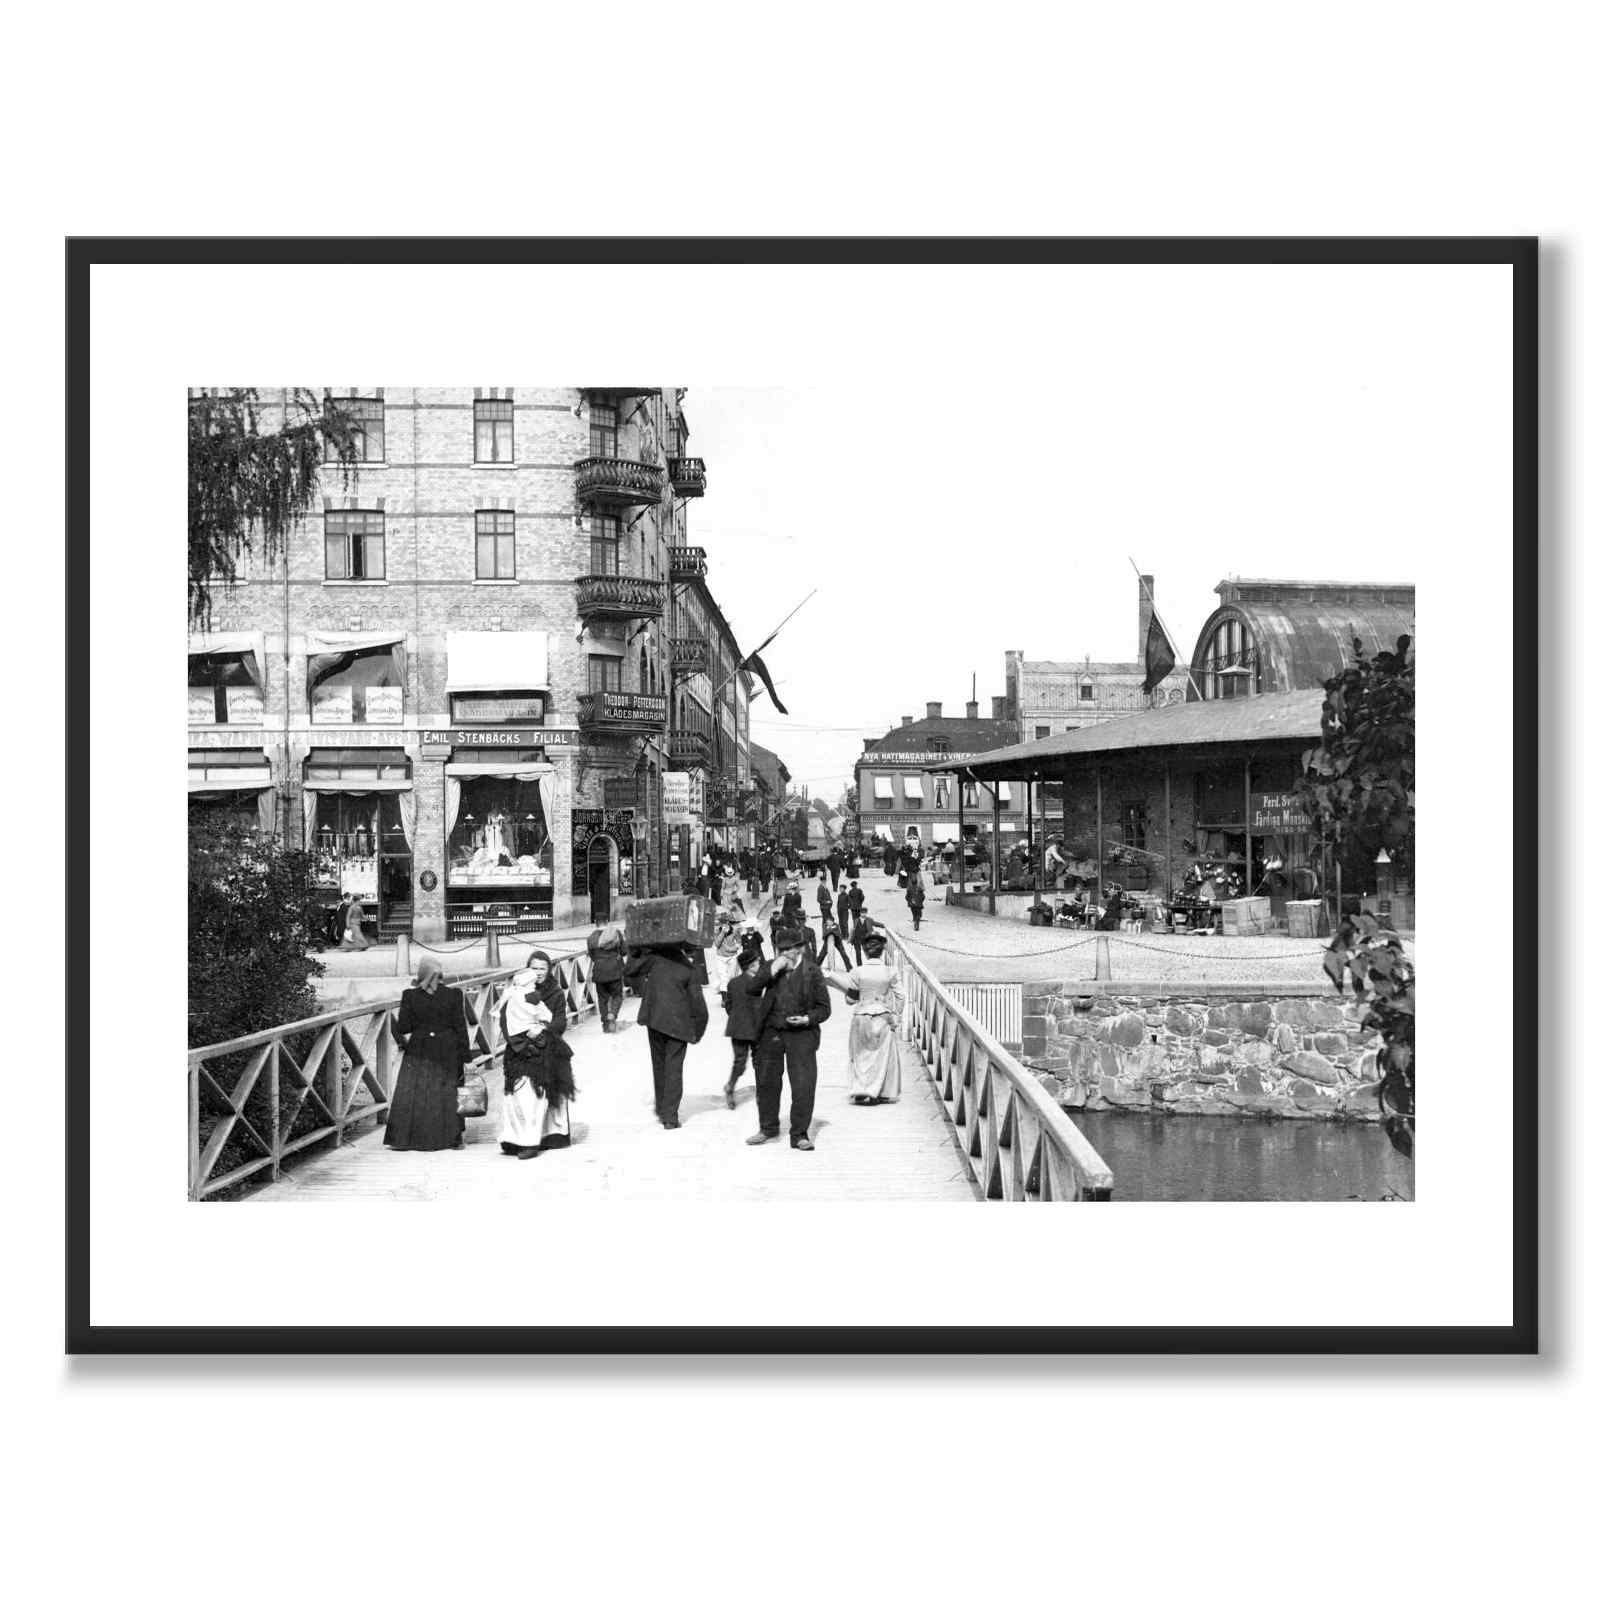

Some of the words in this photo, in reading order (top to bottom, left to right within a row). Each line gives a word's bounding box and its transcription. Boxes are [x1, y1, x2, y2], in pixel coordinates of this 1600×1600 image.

[423, 732, 449, 744] EMIL
[533, 731, 569, 744] FILIAL
[864, 752, 879, 761] NYA
